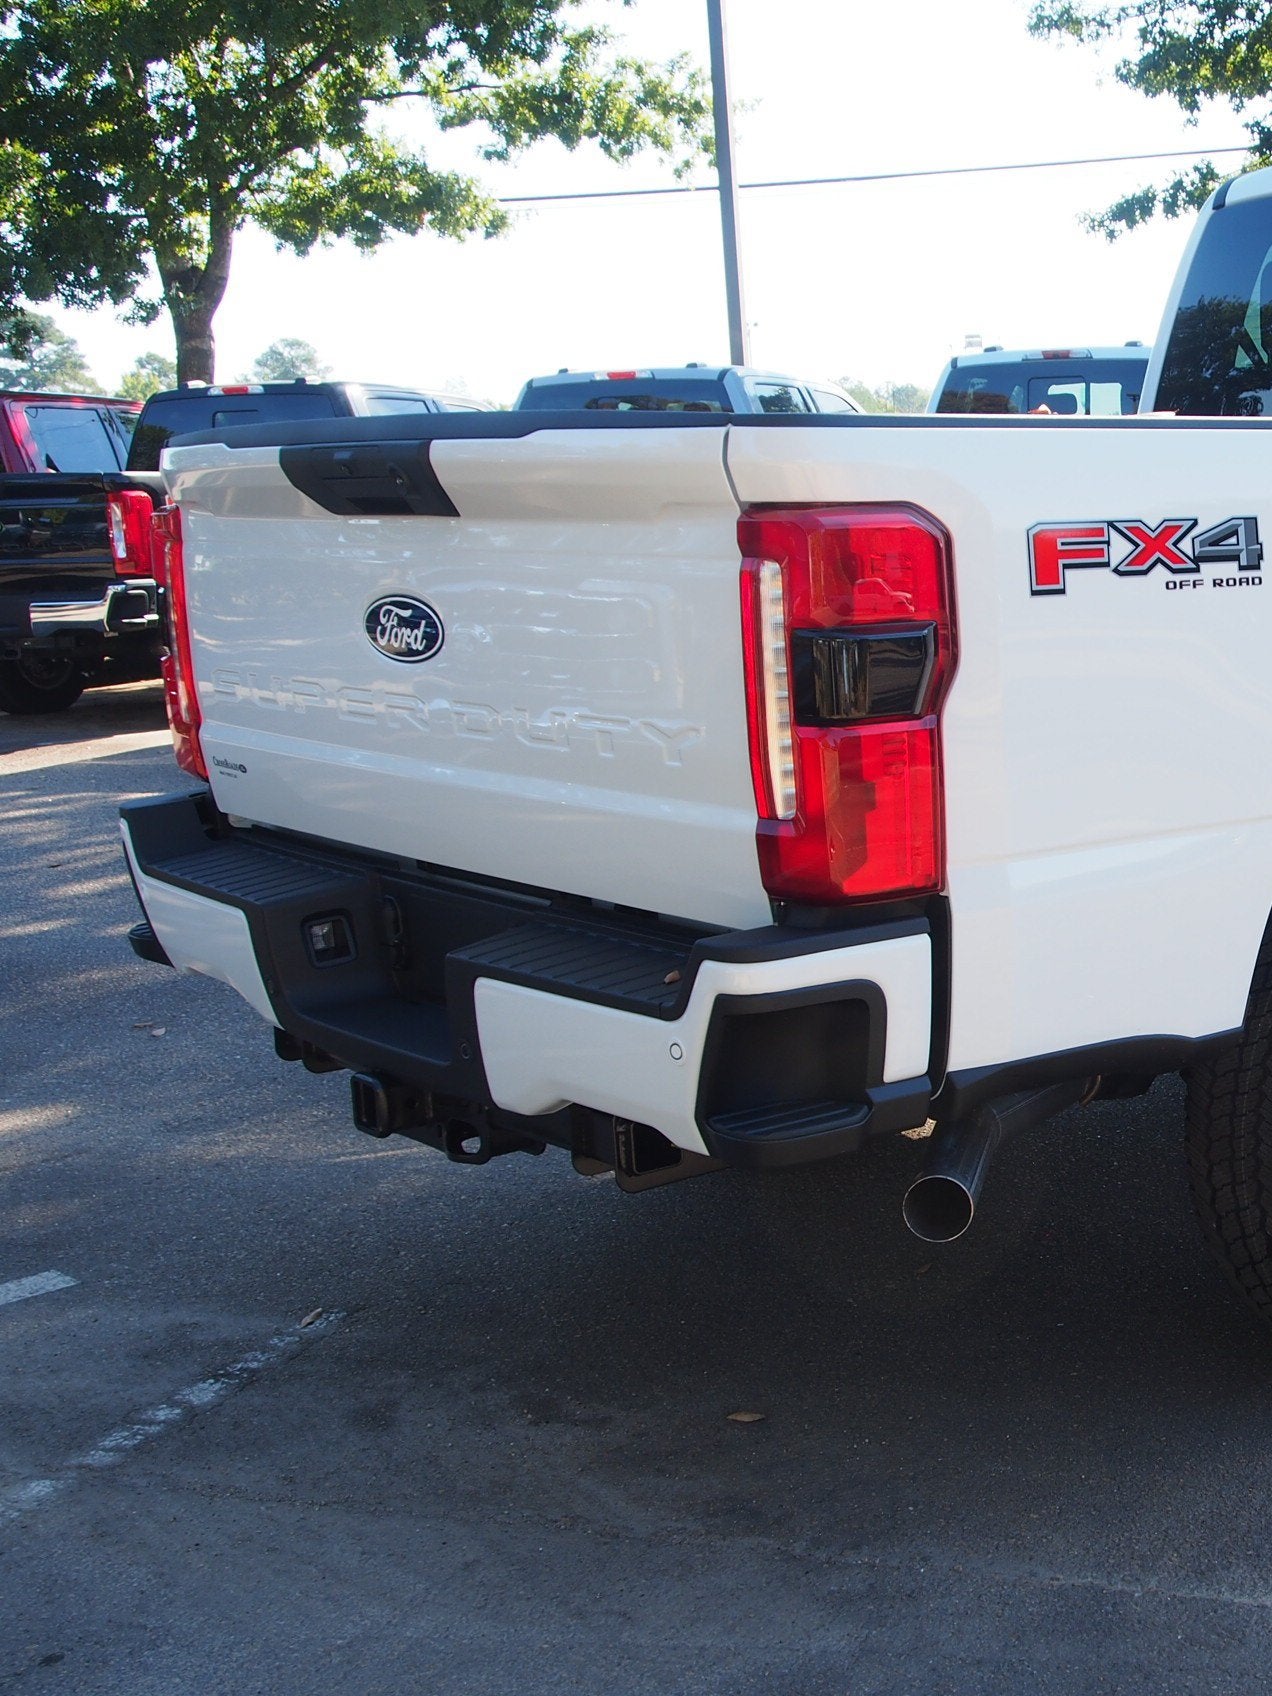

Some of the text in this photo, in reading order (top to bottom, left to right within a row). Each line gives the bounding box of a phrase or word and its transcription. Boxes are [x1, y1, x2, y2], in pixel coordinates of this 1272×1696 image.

[1026, 514, 1264, 597] FX4
[1165, 576, 1263, 591] OFF ROAD
[375, 603, 428, 653] Ford
[210, 667, 707, 767] SUPER DUTY
